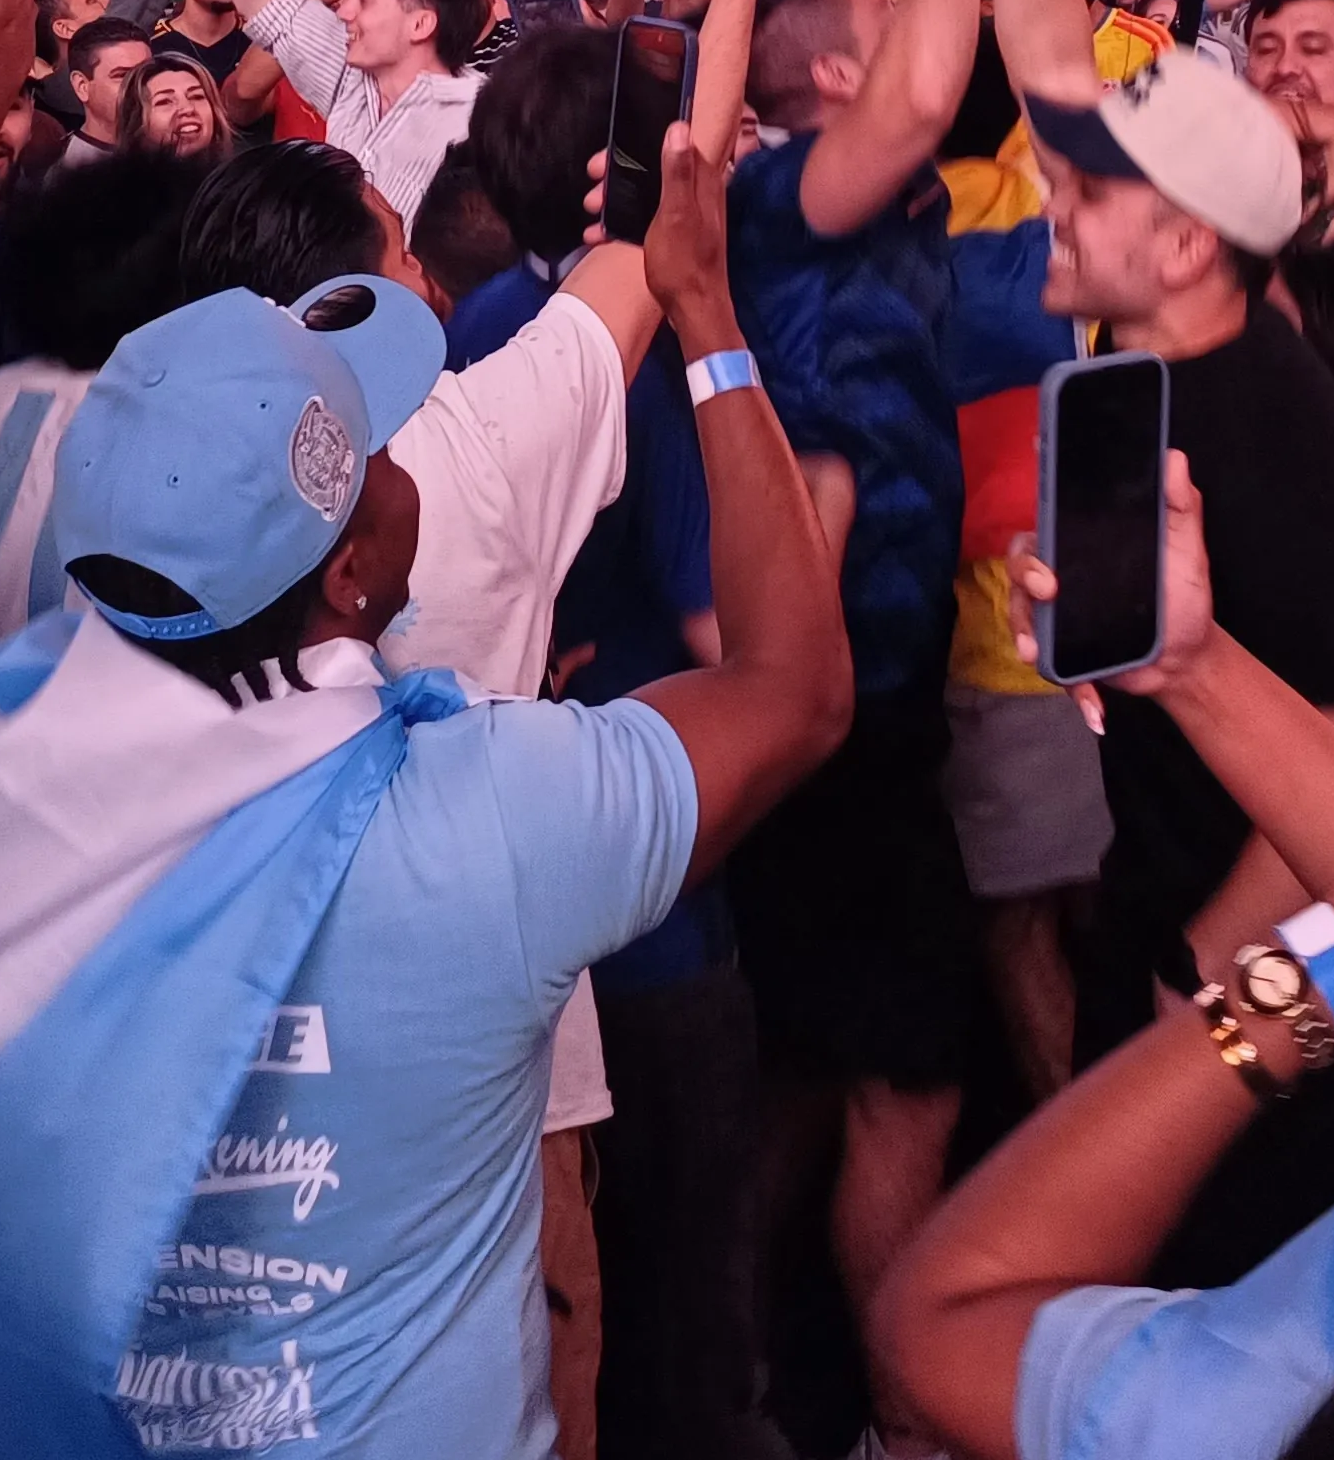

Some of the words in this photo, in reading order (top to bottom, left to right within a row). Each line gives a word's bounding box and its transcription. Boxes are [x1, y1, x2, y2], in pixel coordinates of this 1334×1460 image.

[214, 1115, 339, 1222] ening
[158, 1243, 349, 1294] ENSION
[155, 1284, 272, 1305] AISING
